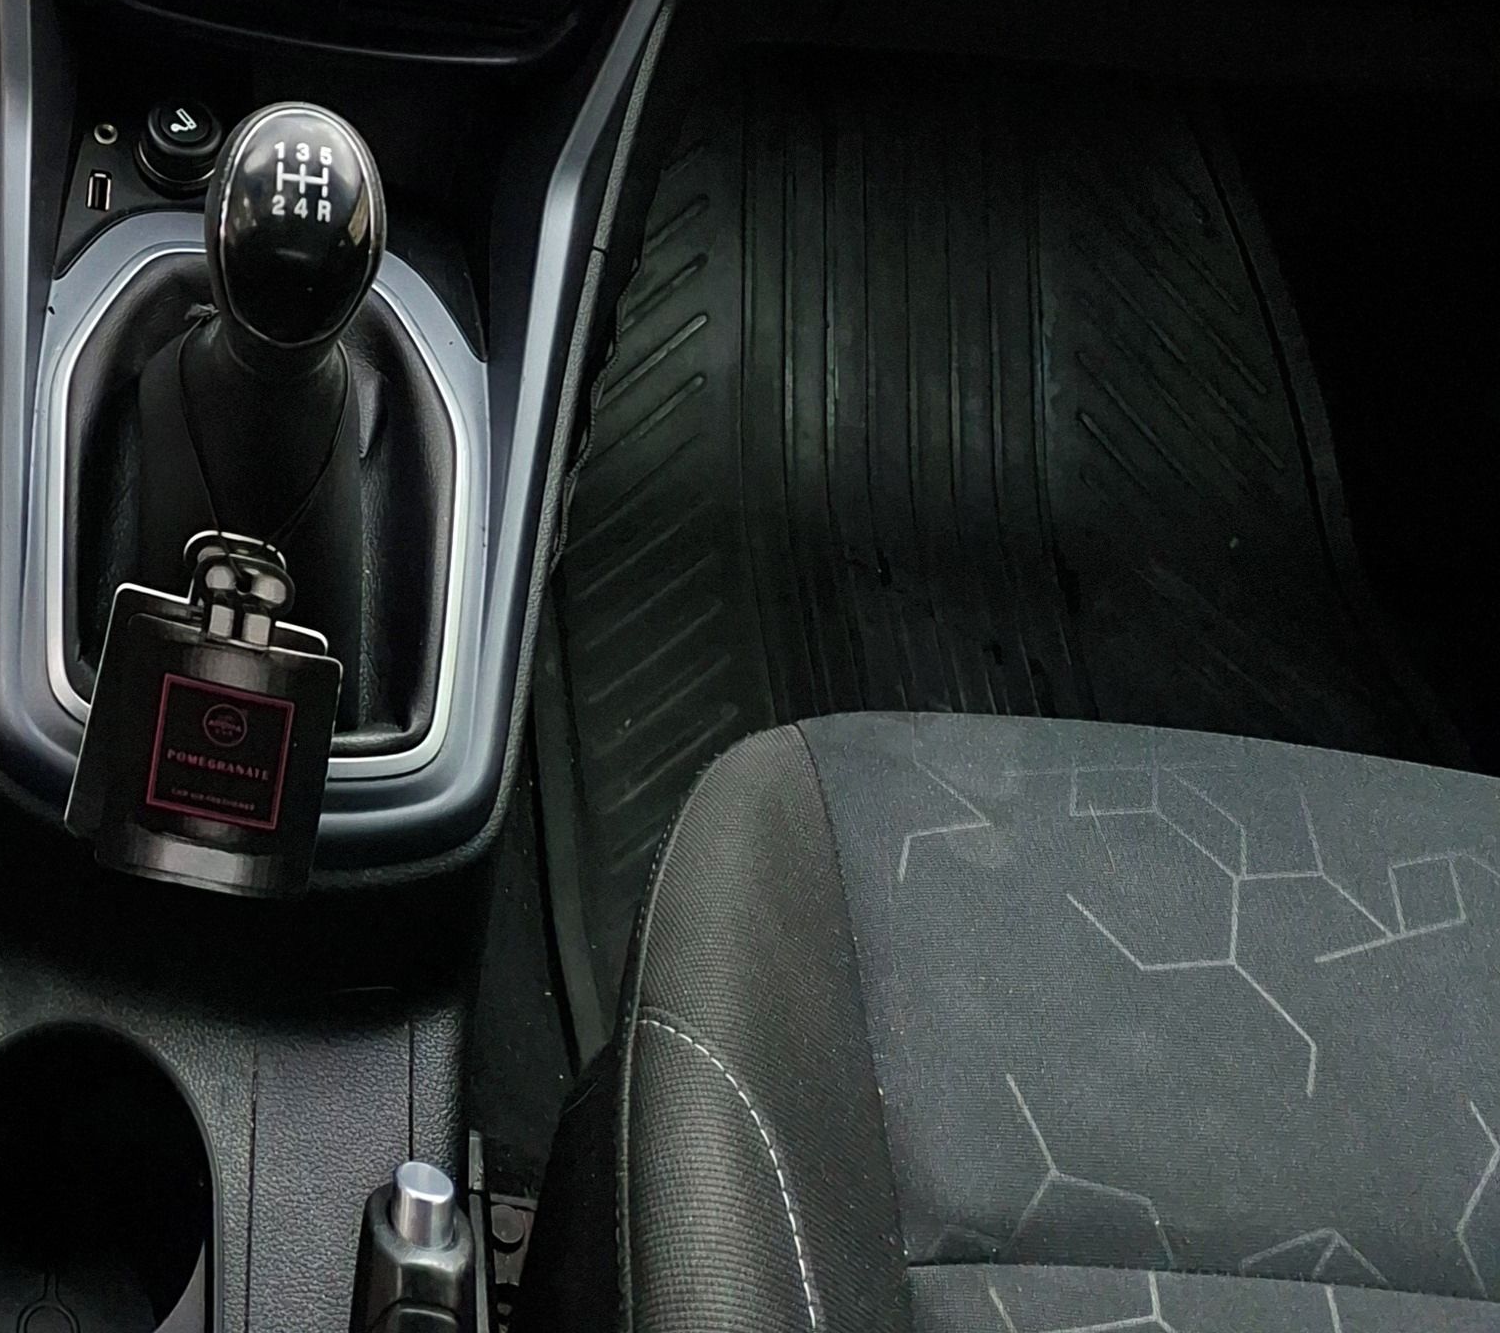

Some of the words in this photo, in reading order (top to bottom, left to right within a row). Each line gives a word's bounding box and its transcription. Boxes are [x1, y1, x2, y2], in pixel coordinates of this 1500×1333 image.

[273, 142, 285, 159] 1
[295, 142, 310, 162] 3
[319, 146, 333, 166] 5
[271, 194, 286, 216] 2
[293, 198, 309, 219] 4
[317, 199, 332, 223] R
[166, 747, 270, 782] POMEGRANATE
